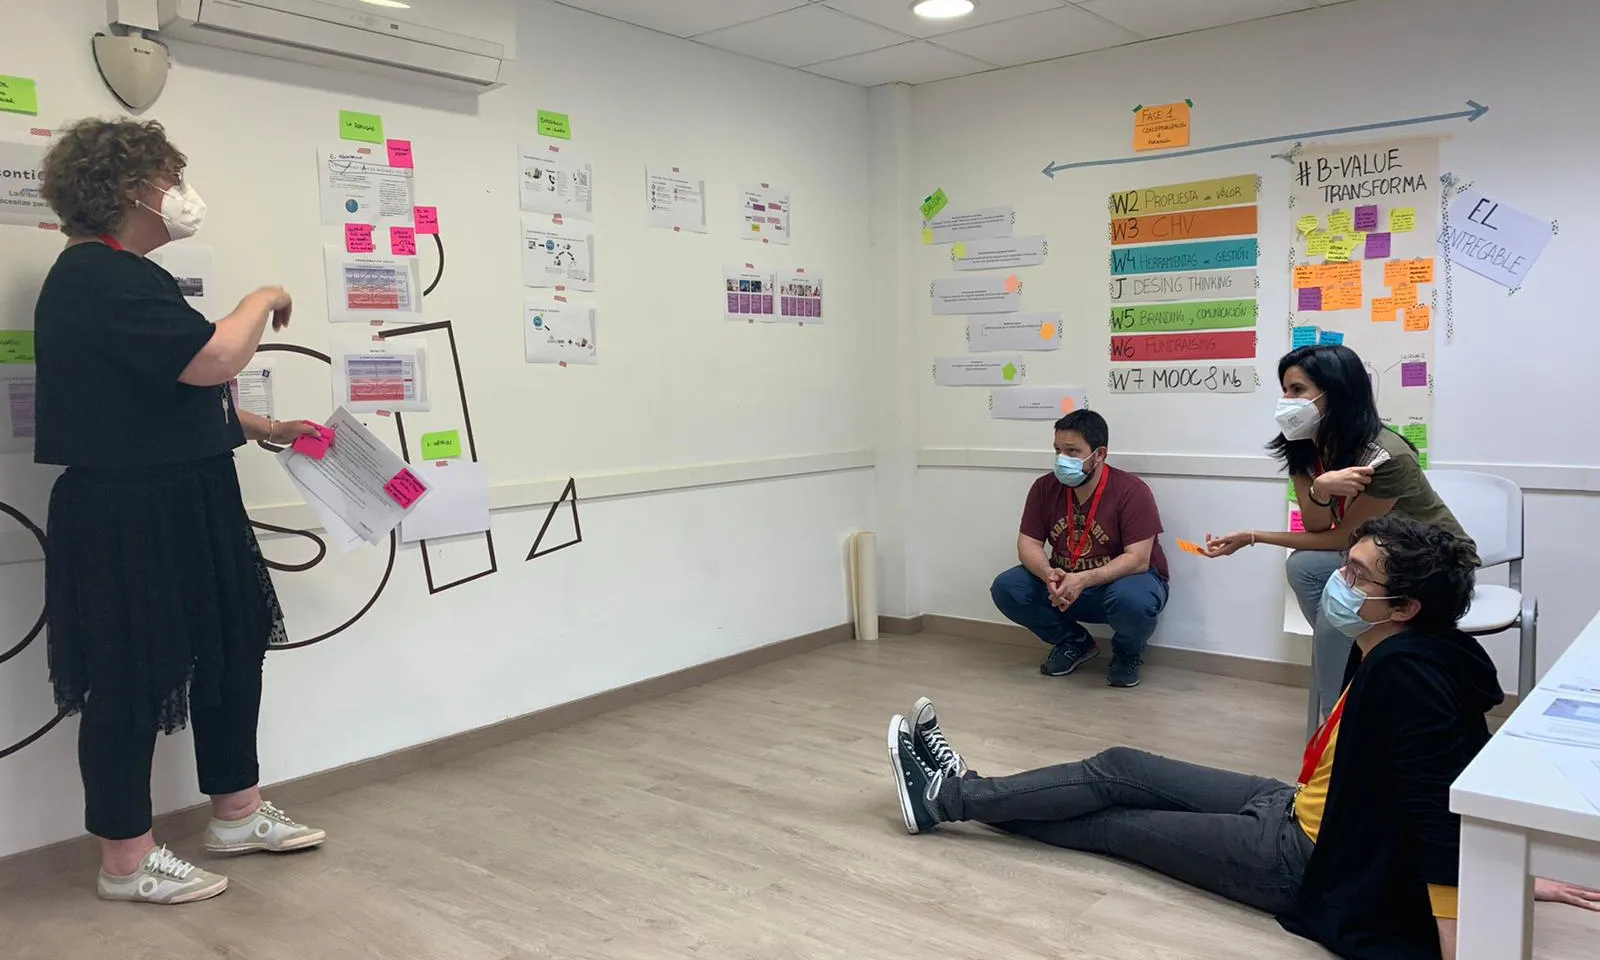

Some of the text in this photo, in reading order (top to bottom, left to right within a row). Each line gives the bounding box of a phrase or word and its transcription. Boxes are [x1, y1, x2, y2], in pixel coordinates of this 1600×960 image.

[1111, 186, 1243, 214] W2 PROPUESTA VALOR
[1318, 174, 1427, 204] TRANSFORMA
[1467, 198, 1498, 231] EL
[1112, 215, 1196, 241] W3 CHV
[1112, 249, 1136, 273] W4
[1437, 224, 1528, 276] ENTREGABLE
[1111, 275, 1232, 299] J DESING THINKING
[1112, 308, 1135, 330] W5
[1139, 309, 1184, 326] BRANDING
[1111, 337, 1217, 358] W6 FUNDRAISING
[1112, 368, 1144, 391] W7
[1152, 368, 1202, 389] MOOC
